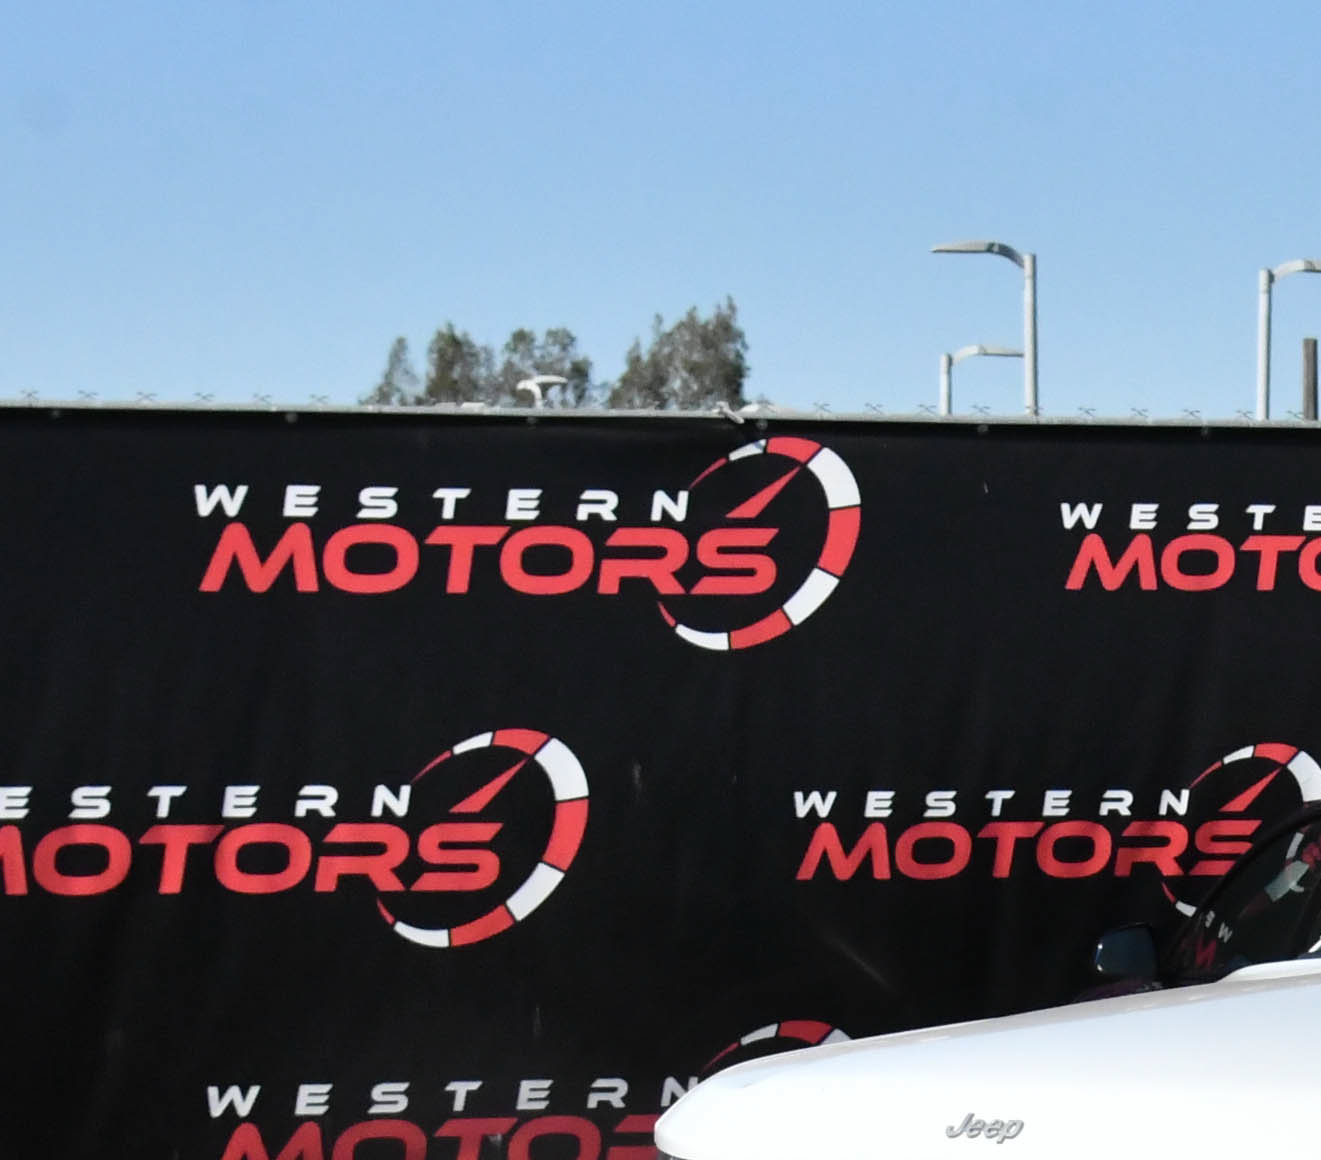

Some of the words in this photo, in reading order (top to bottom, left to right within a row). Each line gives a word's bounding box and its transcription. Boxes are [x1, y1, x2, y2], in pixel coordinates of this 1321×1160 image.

[194, 485, 689, 522] WESTERN
[200, 522, 780, 595] MOTORS
[793, 789, 1190, 819] WESTERN
[0, 822, 503, 896] OTORS
[797, 820, 1262, 880] MOTORS
[945, 1113, 1025, 1144] Jeep
